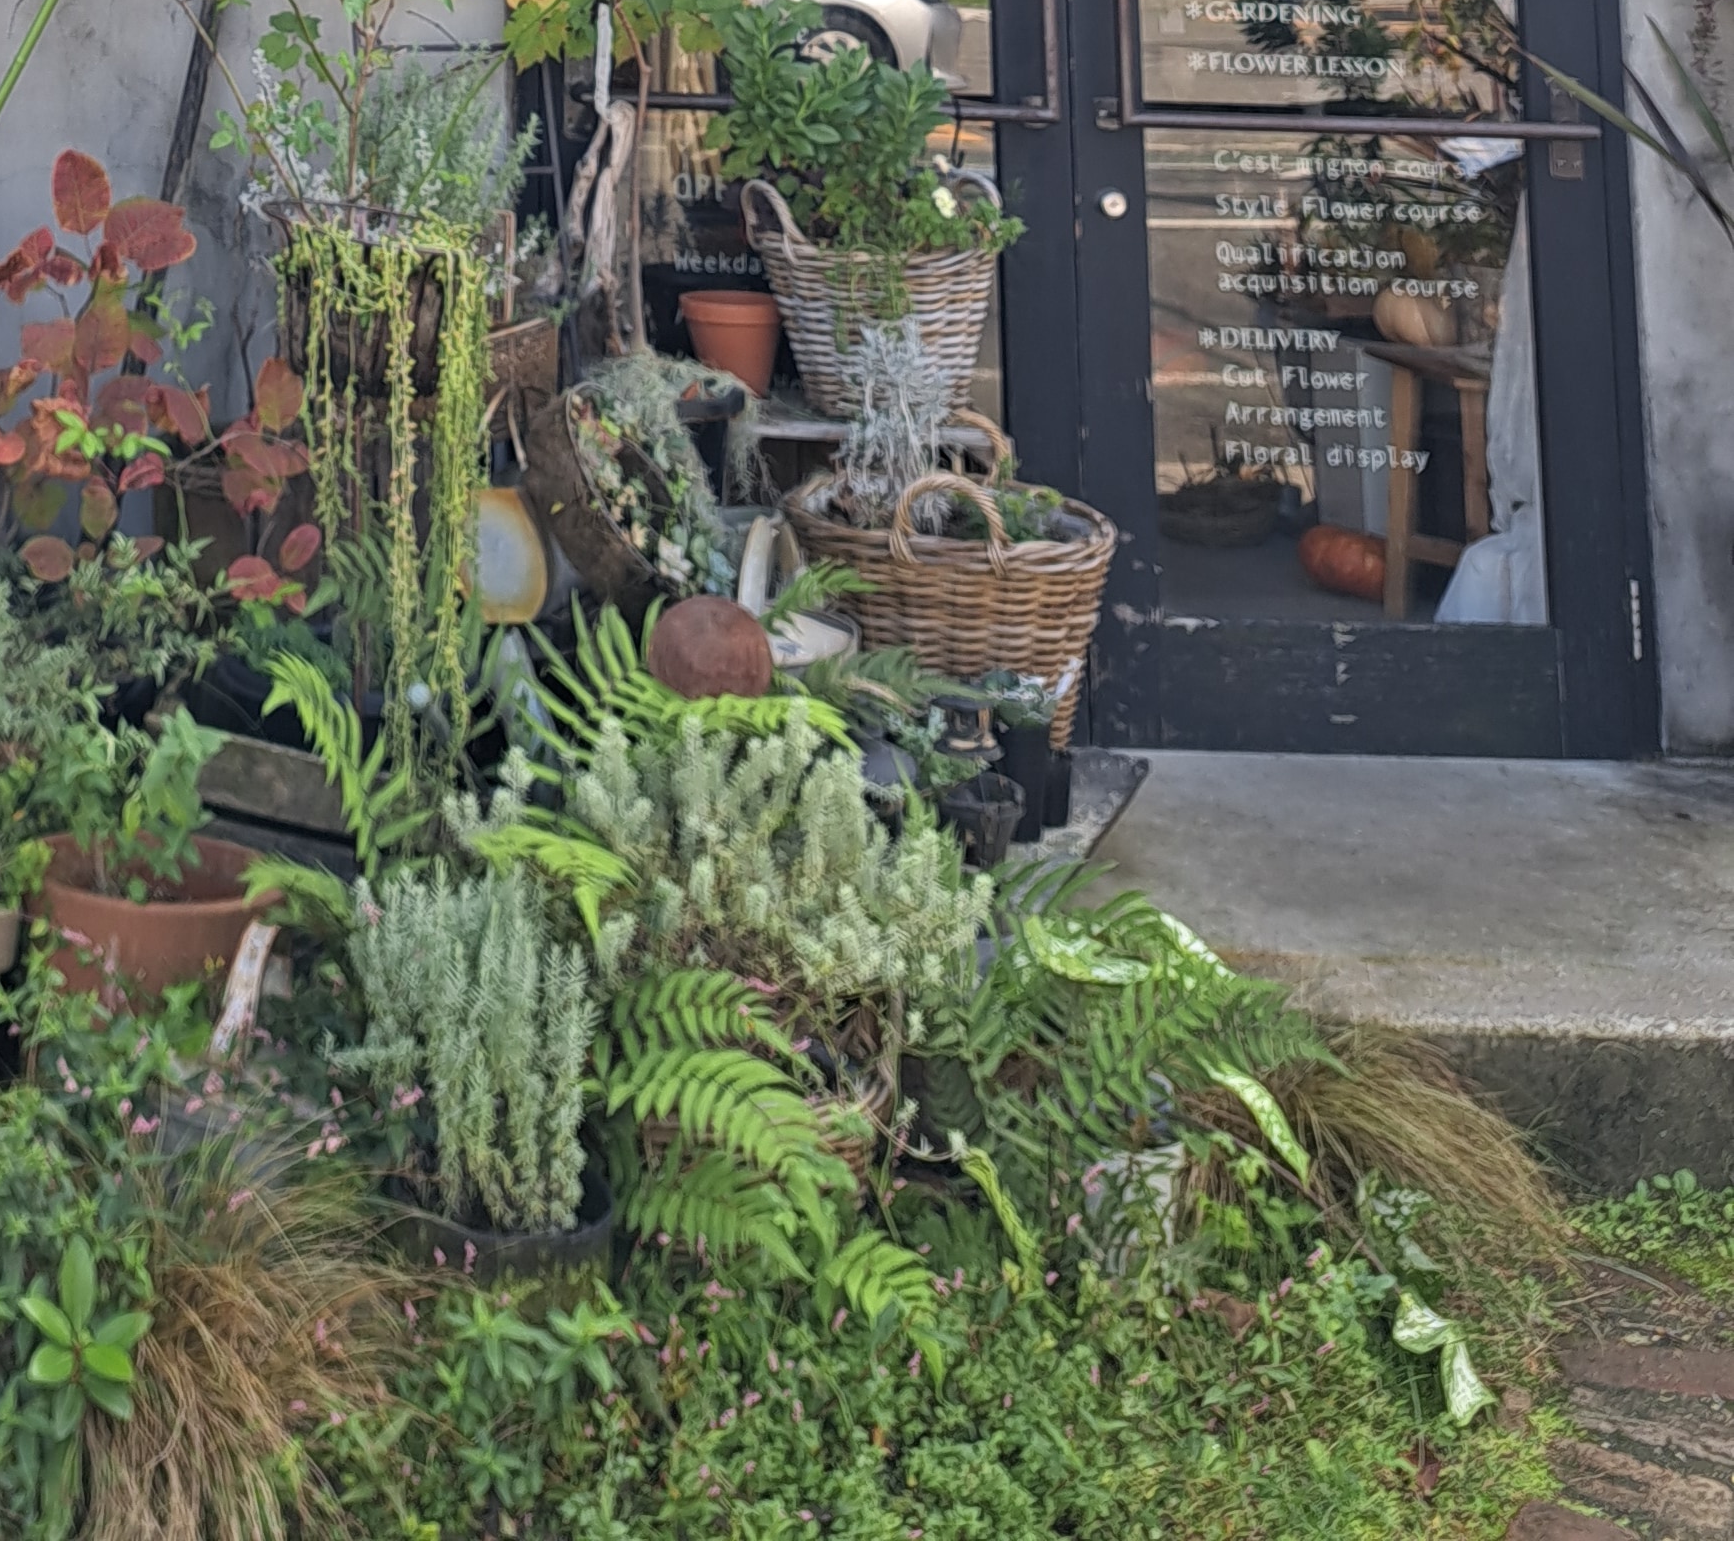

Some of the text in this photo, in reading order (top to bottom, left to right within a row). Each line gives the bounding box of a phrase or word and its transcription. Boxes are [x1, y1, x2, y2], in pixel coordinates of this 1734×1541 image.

[1204, 0, 1362, 25] GARDENING
[1207, 51, 1407, 79] FLOWER LESSON
[1295, 153, 1386, 180] mignon
[1393, 157, 1481, 179] course
[1214, 193, 1485, 224] Style Flower course
[673, 248, 763, 276] Weekda
[1214, 240, 1407, 270] Qualification
[1217, 270, 1480, 300] acquisition course
[1218, 325, 1342, 353] DELIVERY
[1221, 363, 1370, 392] Cut Flower
[1224, 400, 1388, 432] Arrangement
[1223, 439, 1431, 475] Floral display
